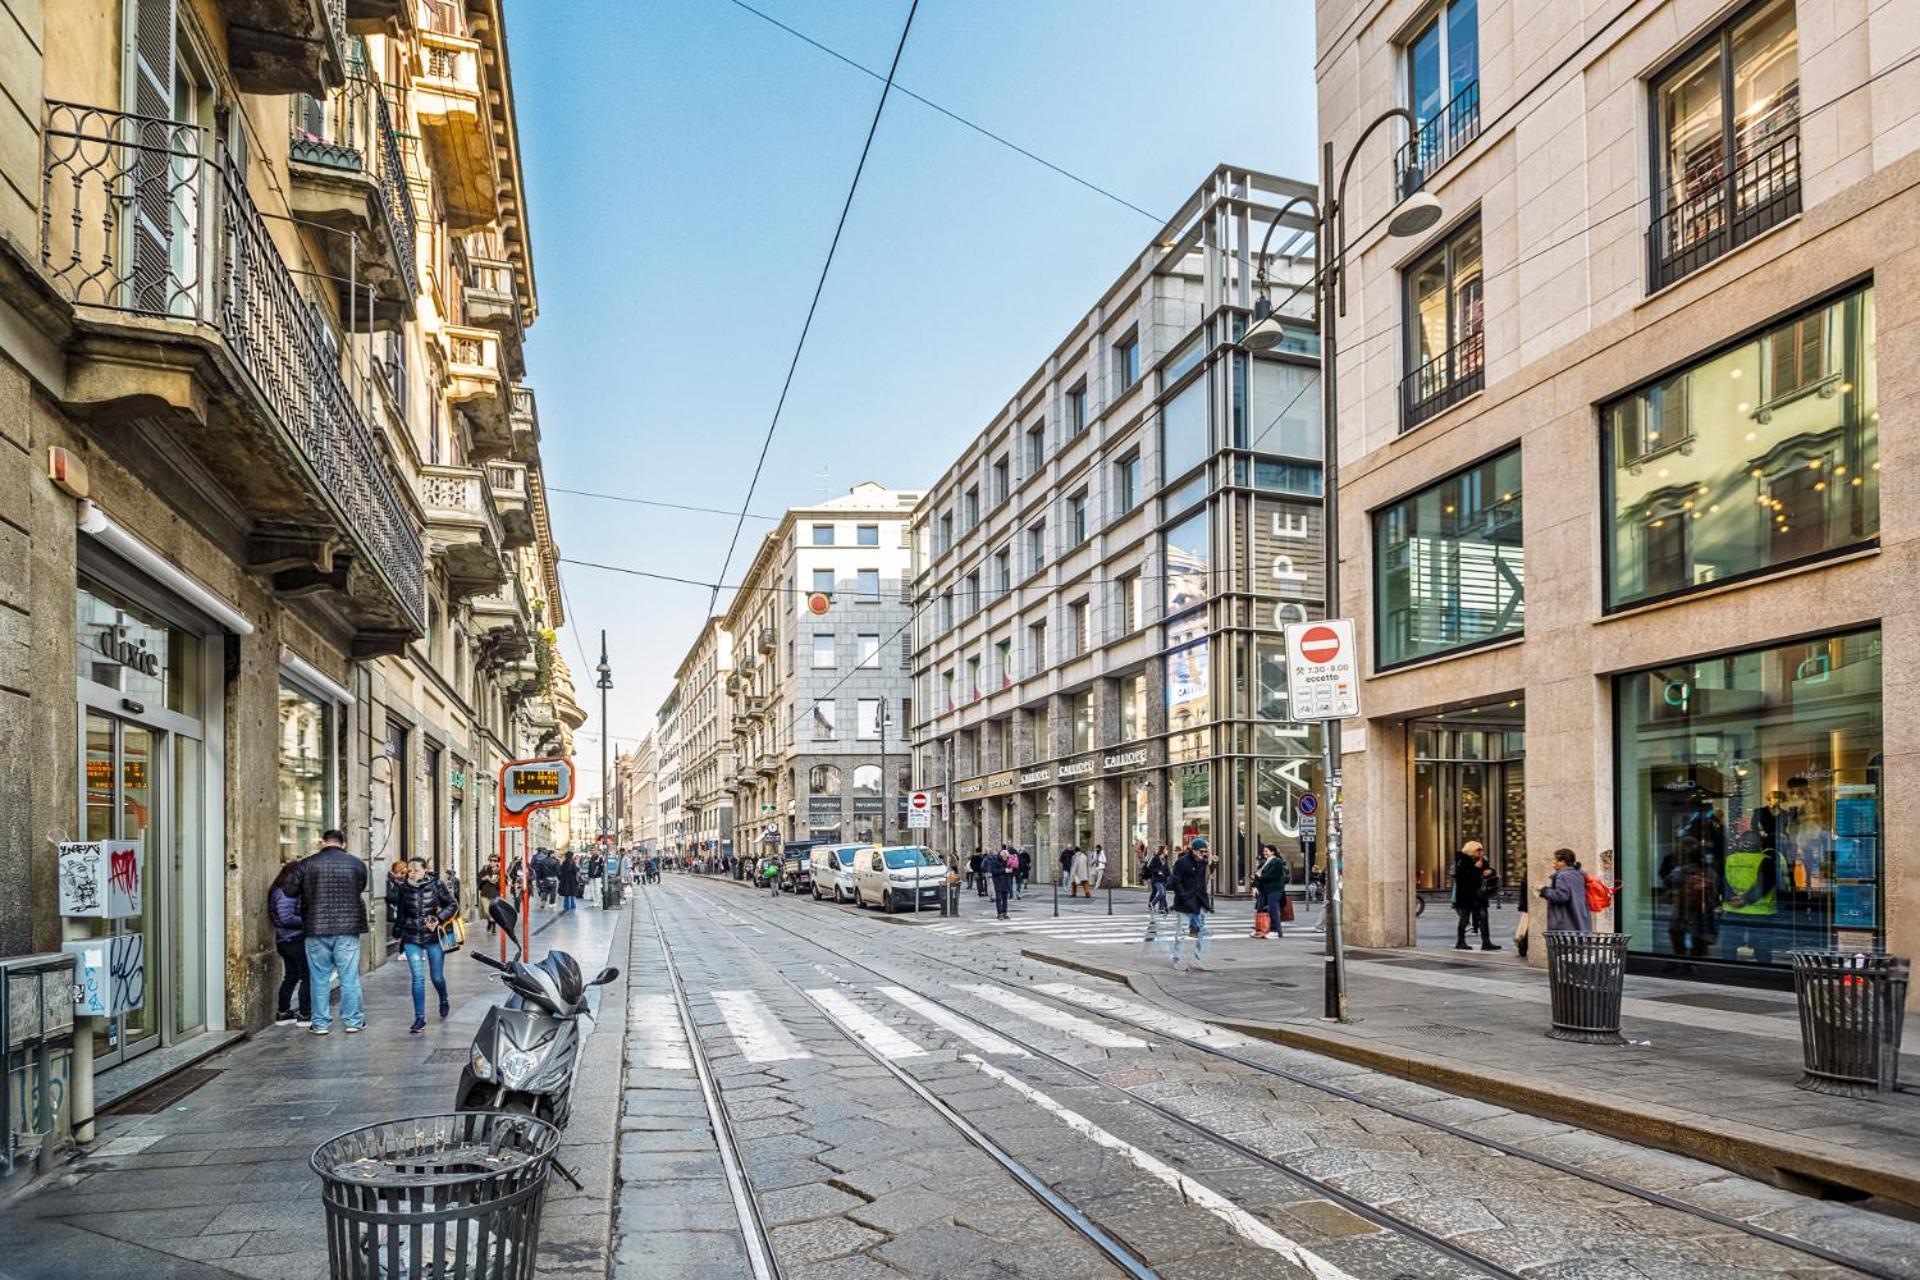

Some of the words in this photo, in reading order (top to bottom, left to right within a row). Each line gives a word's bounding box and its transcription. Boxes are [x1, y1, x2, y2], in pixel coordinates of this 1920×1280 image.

[101, 625, 158, 677] dixie
[1305, 673, 1340, 683] eccetto
[1104, 749, 1147, 768] CALLIOPE
